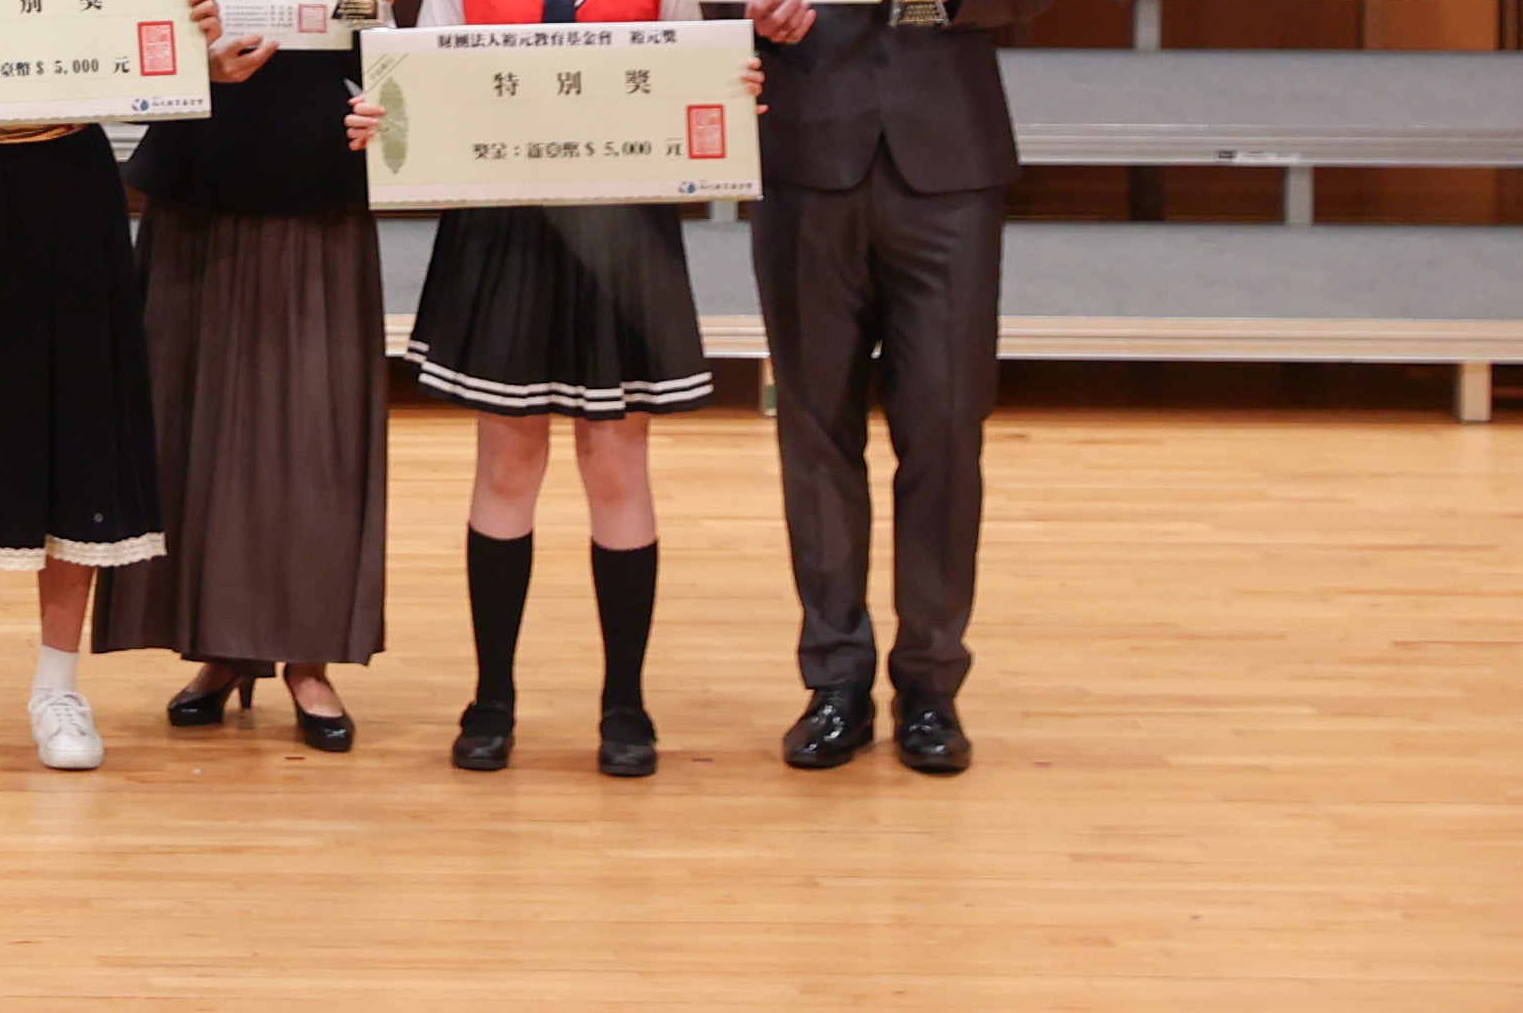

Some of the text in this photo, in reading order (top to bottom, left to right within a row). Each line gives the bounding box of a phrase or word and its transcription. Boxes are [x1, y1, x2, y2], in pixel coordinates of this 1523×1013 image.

[438, 29, 677, 49] 財團法人裕元教育基金會 裕元獎
[55, 58, 99, 76] 5,000
[112, 57, 131, 75] 元
